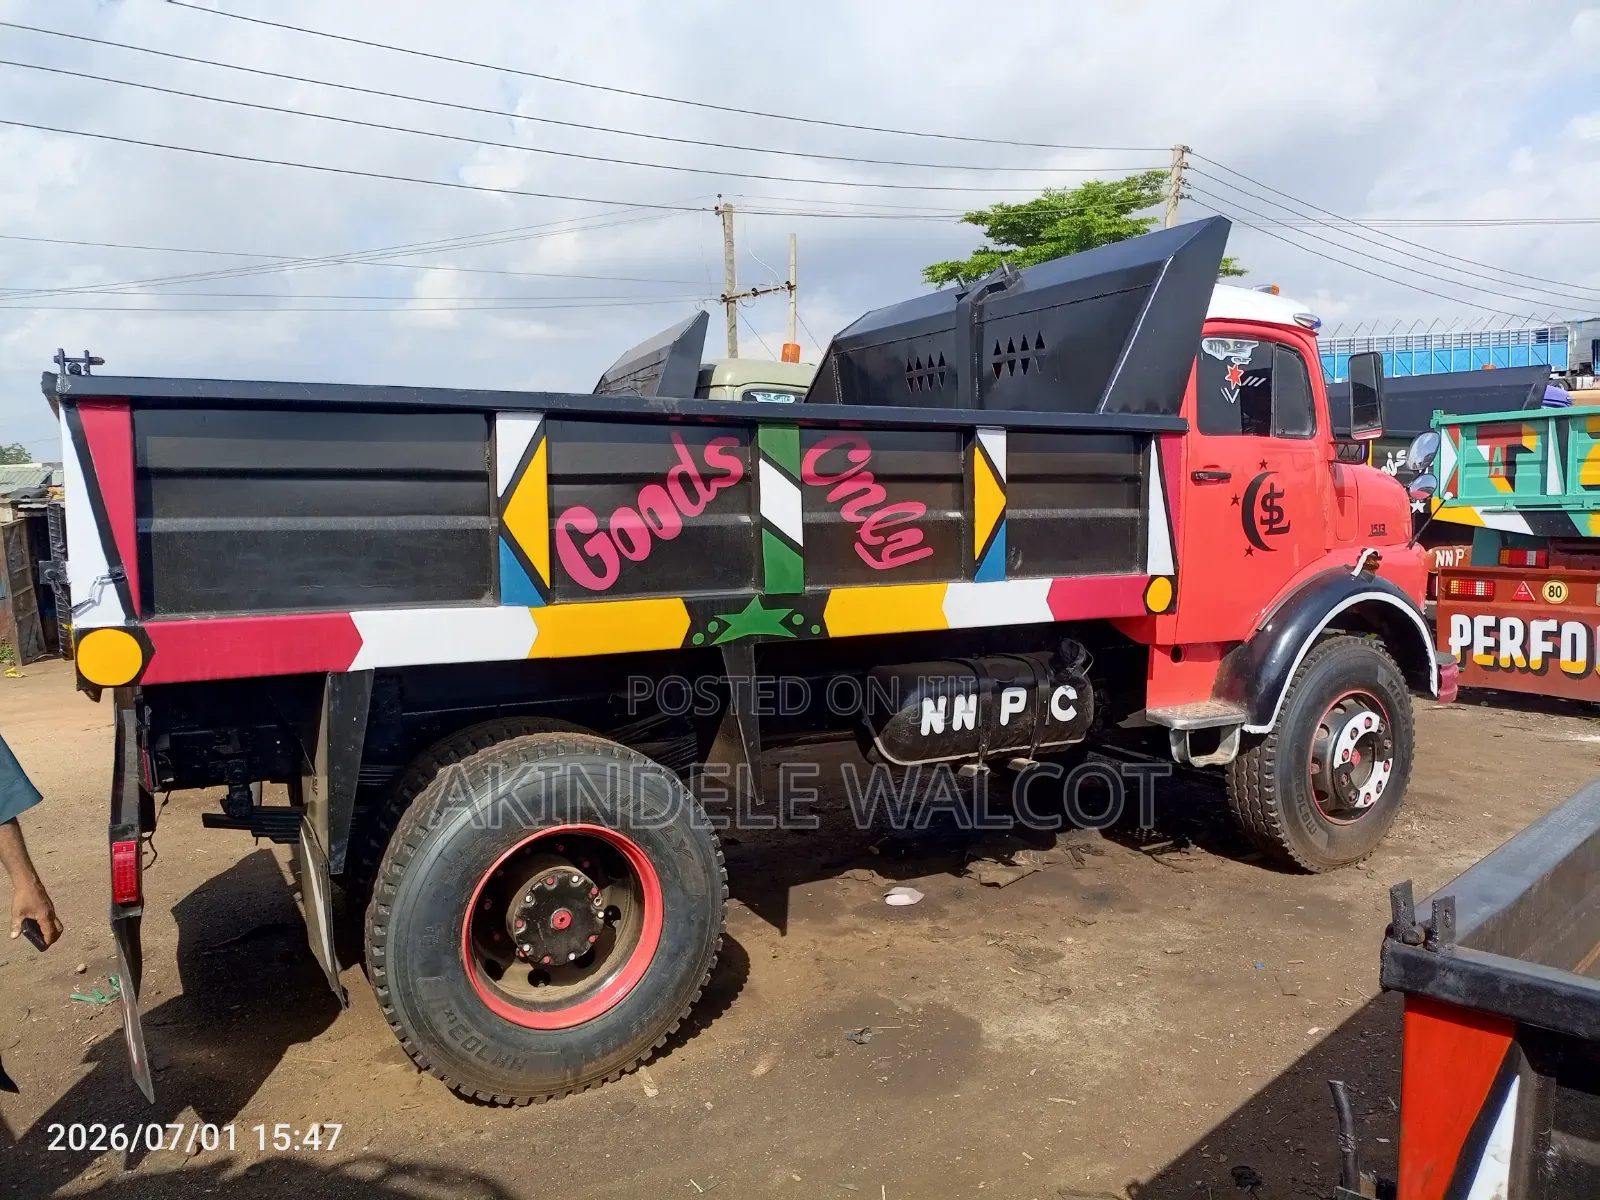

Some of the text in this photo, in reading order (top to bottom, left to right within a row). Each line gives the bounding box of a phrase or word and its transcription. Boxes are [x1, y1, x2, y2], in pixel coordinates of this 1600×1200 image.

[555, 431, 934, 590] Goods Only
[1548, 585, 1562, 598] 80
[1448, 613, 1600, 676] PERFO
